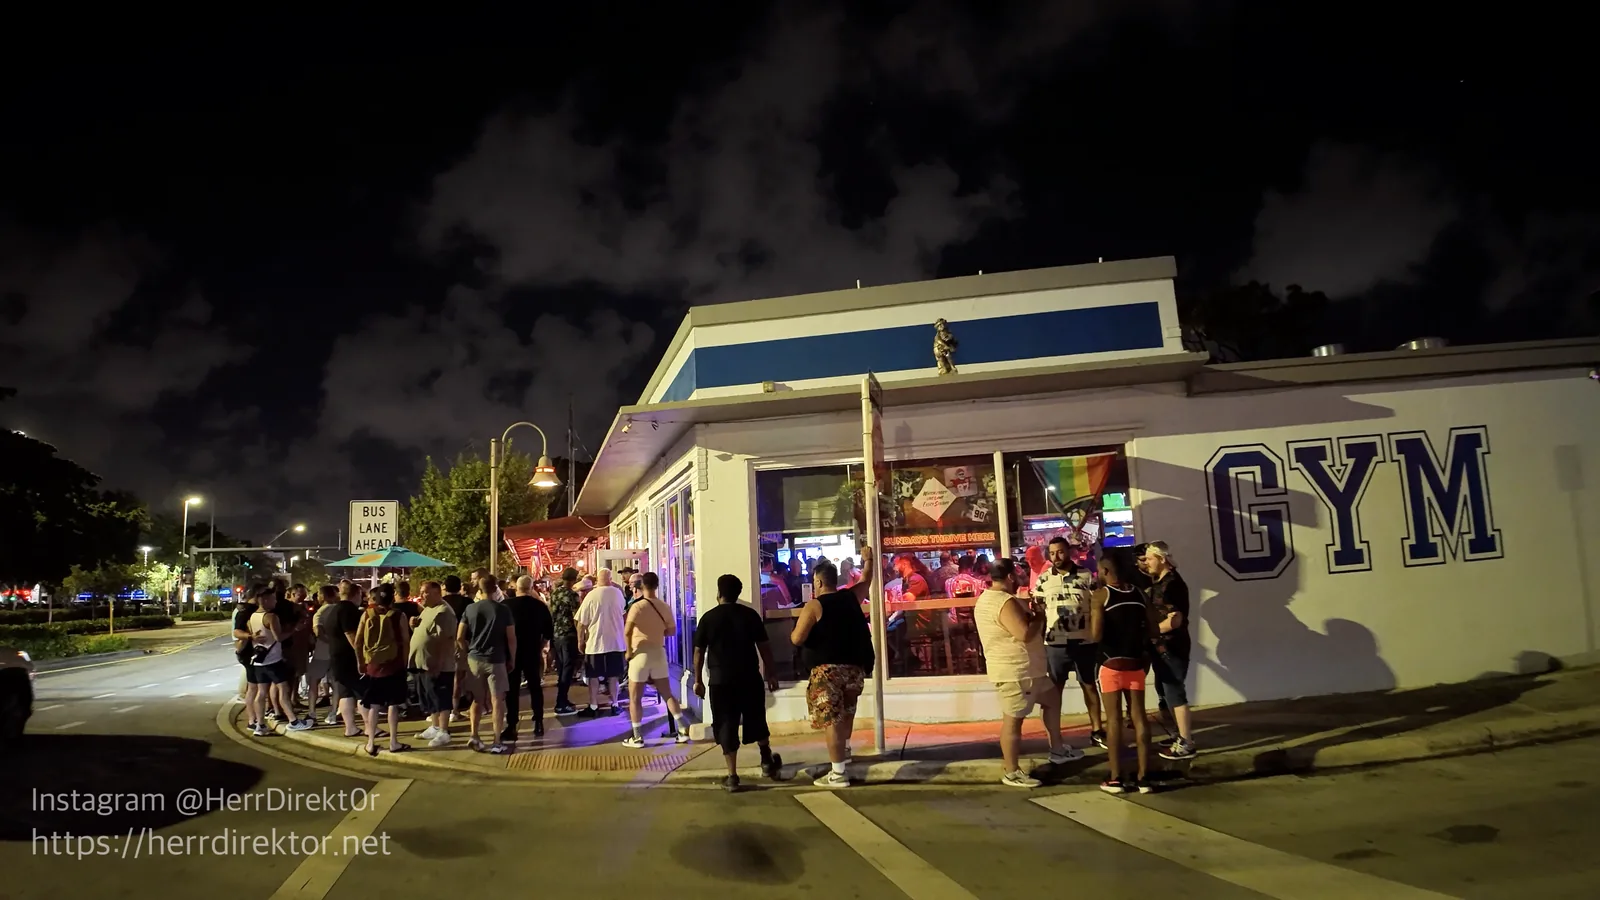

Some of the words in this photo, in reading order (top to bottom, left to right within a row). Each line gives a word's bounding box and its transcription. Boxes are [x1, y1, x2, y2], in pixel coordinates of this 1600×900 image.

[1204, 425, 1504, 581] GYM
[363, 506, 386, 517] BUS
[974, 509, 985, 519] 90
[359, 522, 388, 533] LANE
[355, 538, 392, 550] AHEAD
[883, 535, 929, 546] SUNDAYS
[929, 534, 966, 544] THRIVE
[968, 532, 995, 541] HERE
